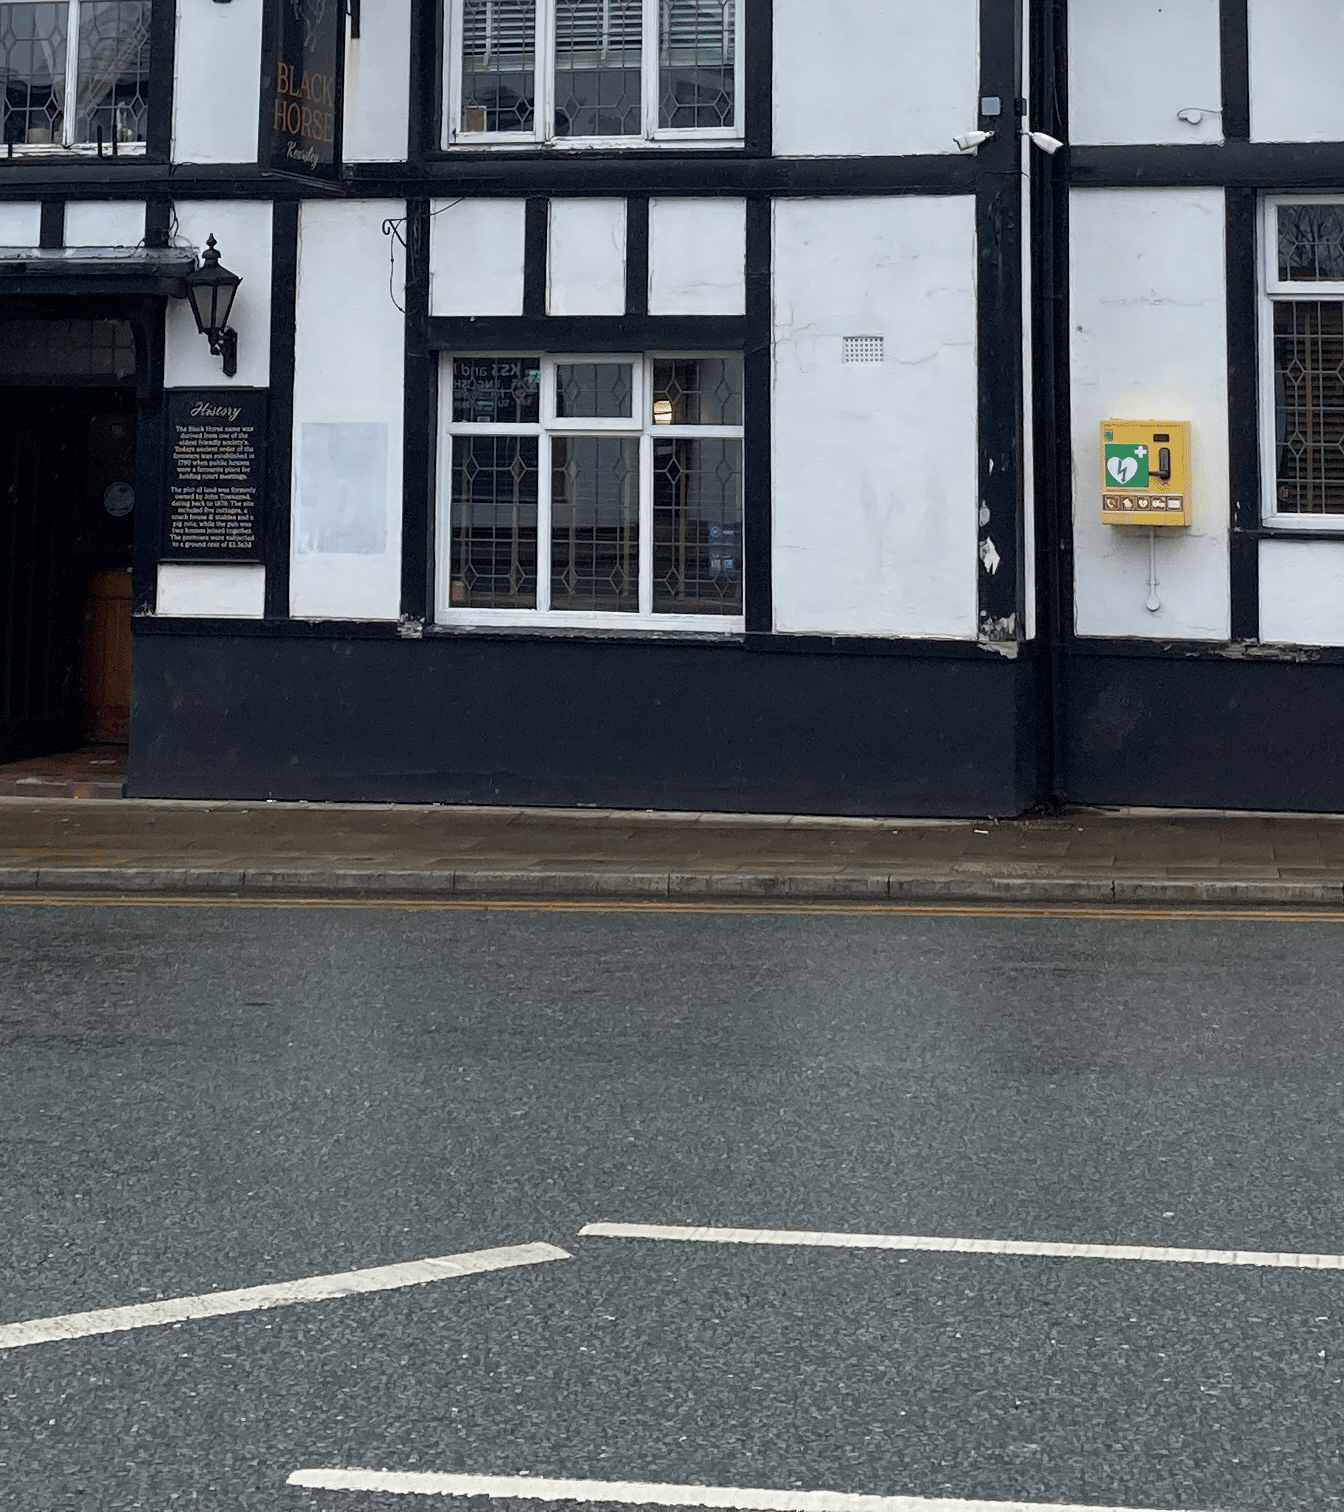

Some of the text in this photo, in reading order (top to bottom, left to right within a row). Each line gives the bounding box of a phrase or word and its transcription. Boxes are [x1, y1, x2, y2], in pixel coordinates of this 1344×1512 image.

[276, 62, 334, 108] BLACK
[273, 98, 334, 143] HORSE
[190, 401, 242, 422] History
